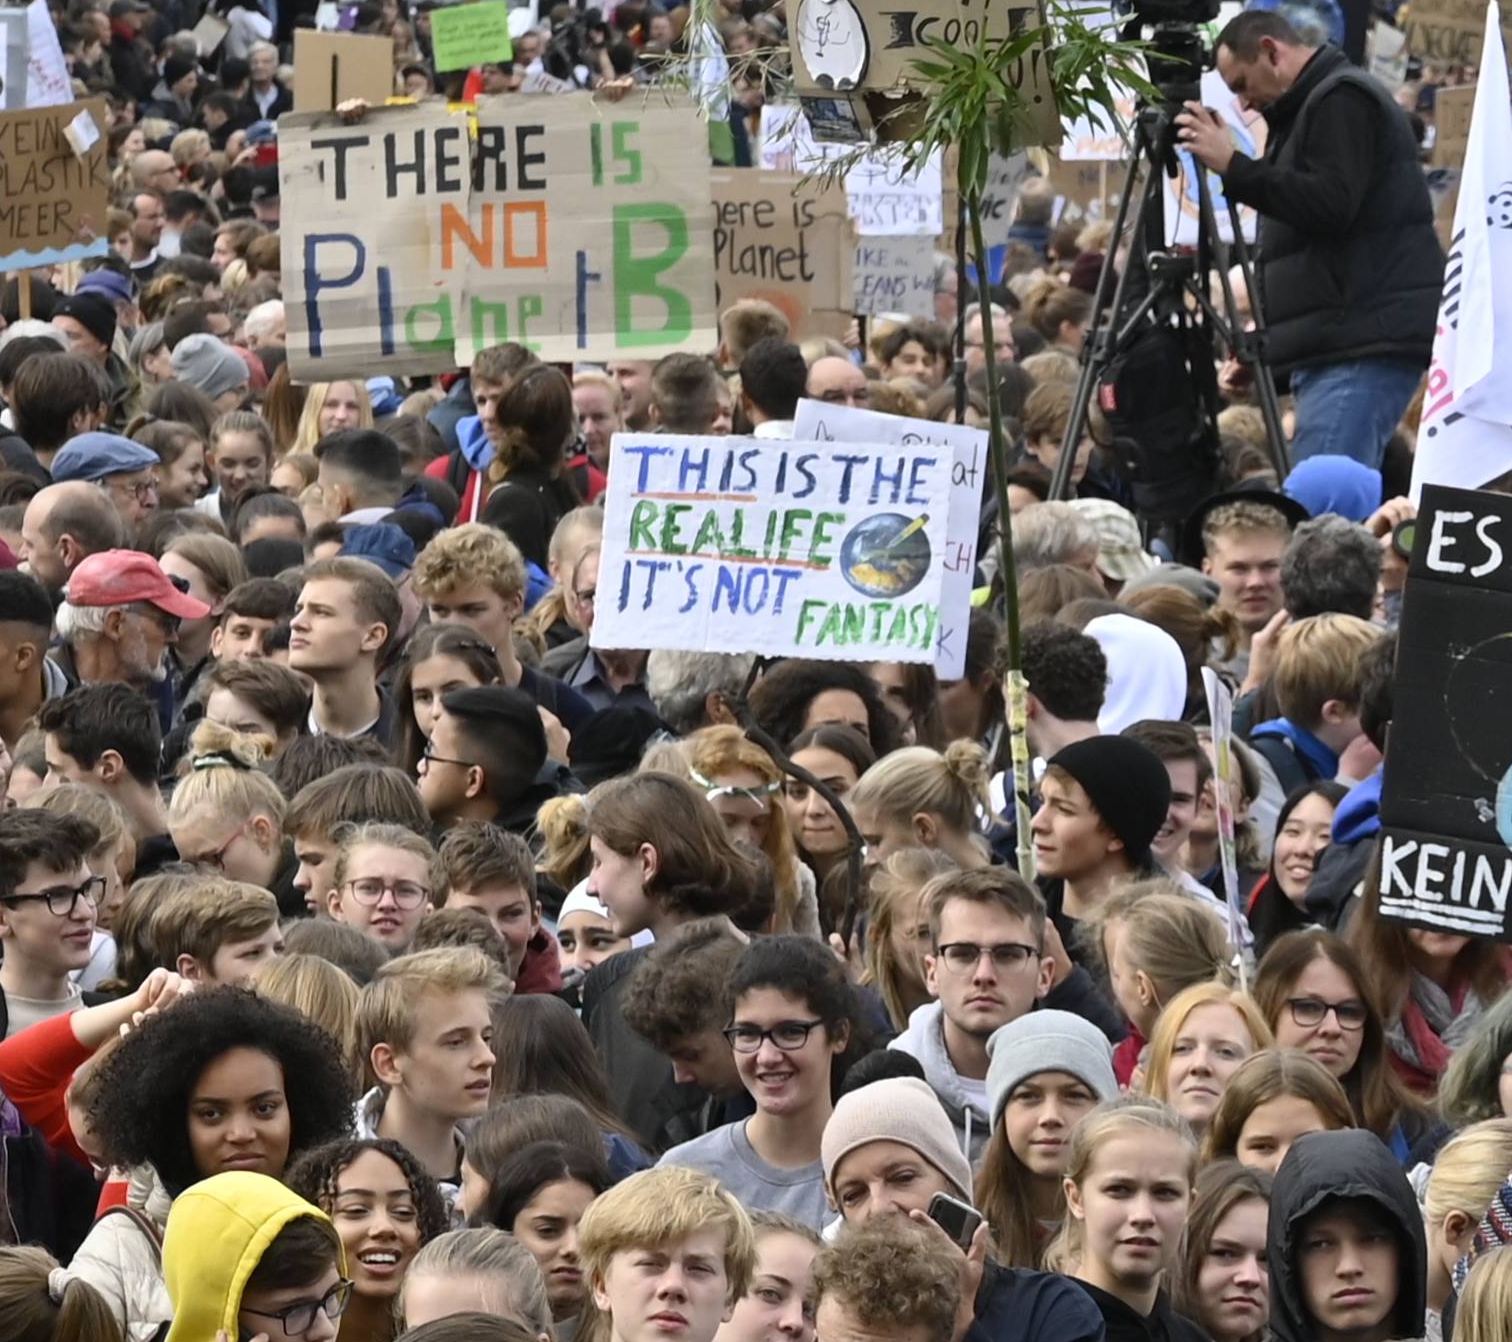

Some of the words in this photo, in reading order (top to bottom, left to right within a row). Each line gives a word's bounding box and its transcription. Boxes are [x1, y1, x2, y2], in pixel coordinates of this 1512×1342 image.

[621, 446, 761, 495] THIS
[774, 451, 820, 500] IS
[831, 454, 938, 505] THE
[1425, 509, 1504, 578] ES
[617, 559, 699, 614] IT'S
[711, 564, 803, 616] NOT
[794, 598, 940, 652] FANTASY
[1379, 836, 1512, 911] KEIN
